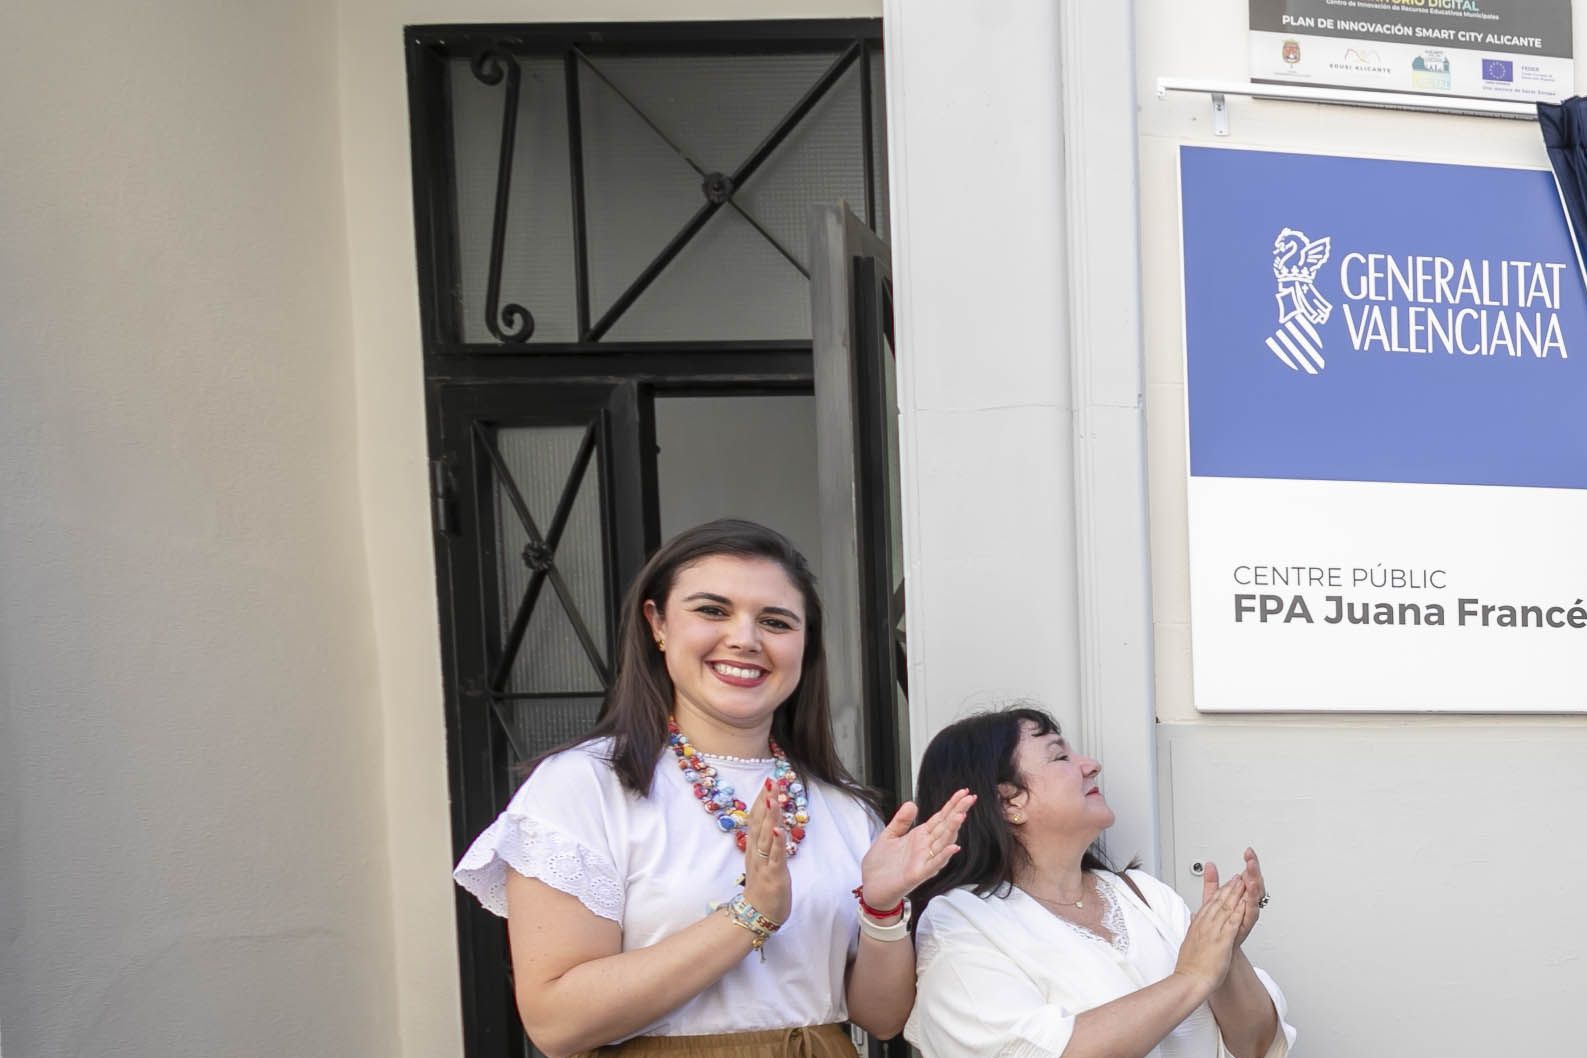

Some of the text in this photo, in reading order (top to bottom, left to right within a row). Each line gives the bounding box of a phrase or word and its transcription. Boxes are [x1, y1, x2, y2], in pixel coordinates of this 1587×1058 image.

[1428, 0, 1480, 11] DIGITAL
[1282, 15, 1543, 48] PLAN DE INNOVACIÓN SMART CITY ALICANTE
[1340, 252, 1567, 310] GENERALITAT
[1342, 303, 1568, 359] VALENCIANA
[1233, 563, 1448, 589] CENTRE PÚBLIC
[1234, 593, 1315, 624] FPA
[1323, 595, 1446, 626] Juana
